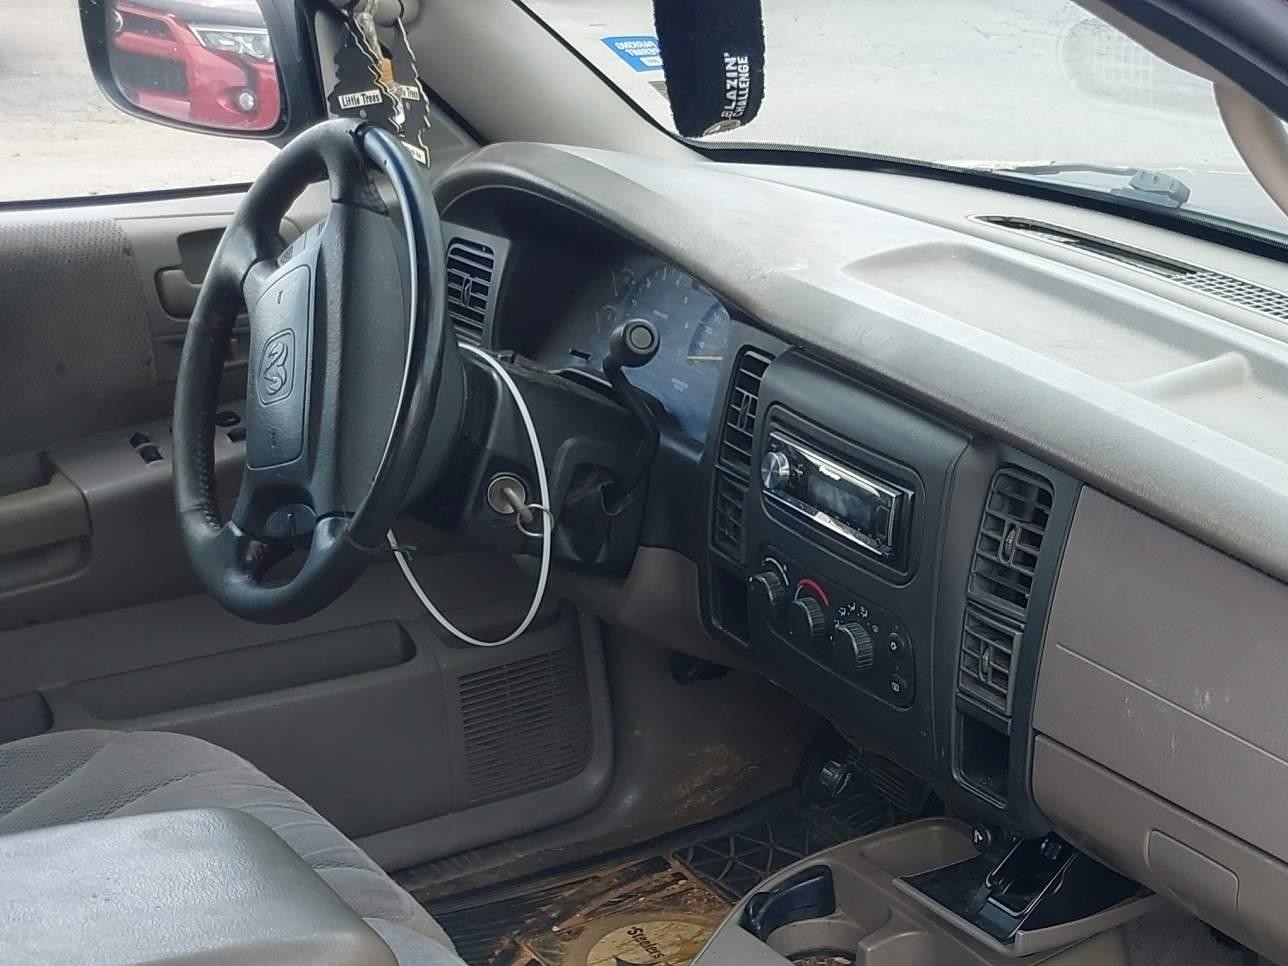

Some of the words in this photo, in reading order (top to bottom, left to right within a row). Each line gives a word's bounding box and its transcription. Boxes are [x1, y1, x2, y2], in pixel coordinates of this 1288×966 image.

[341, 93, 360, 108] Little
[360, 92, 380, 106] Trees
[720, 52, 739, 118] BLAZIN'
[733, 55, 750, 117] CHALLENGE
[626, 926, 665, 960] Steelers
